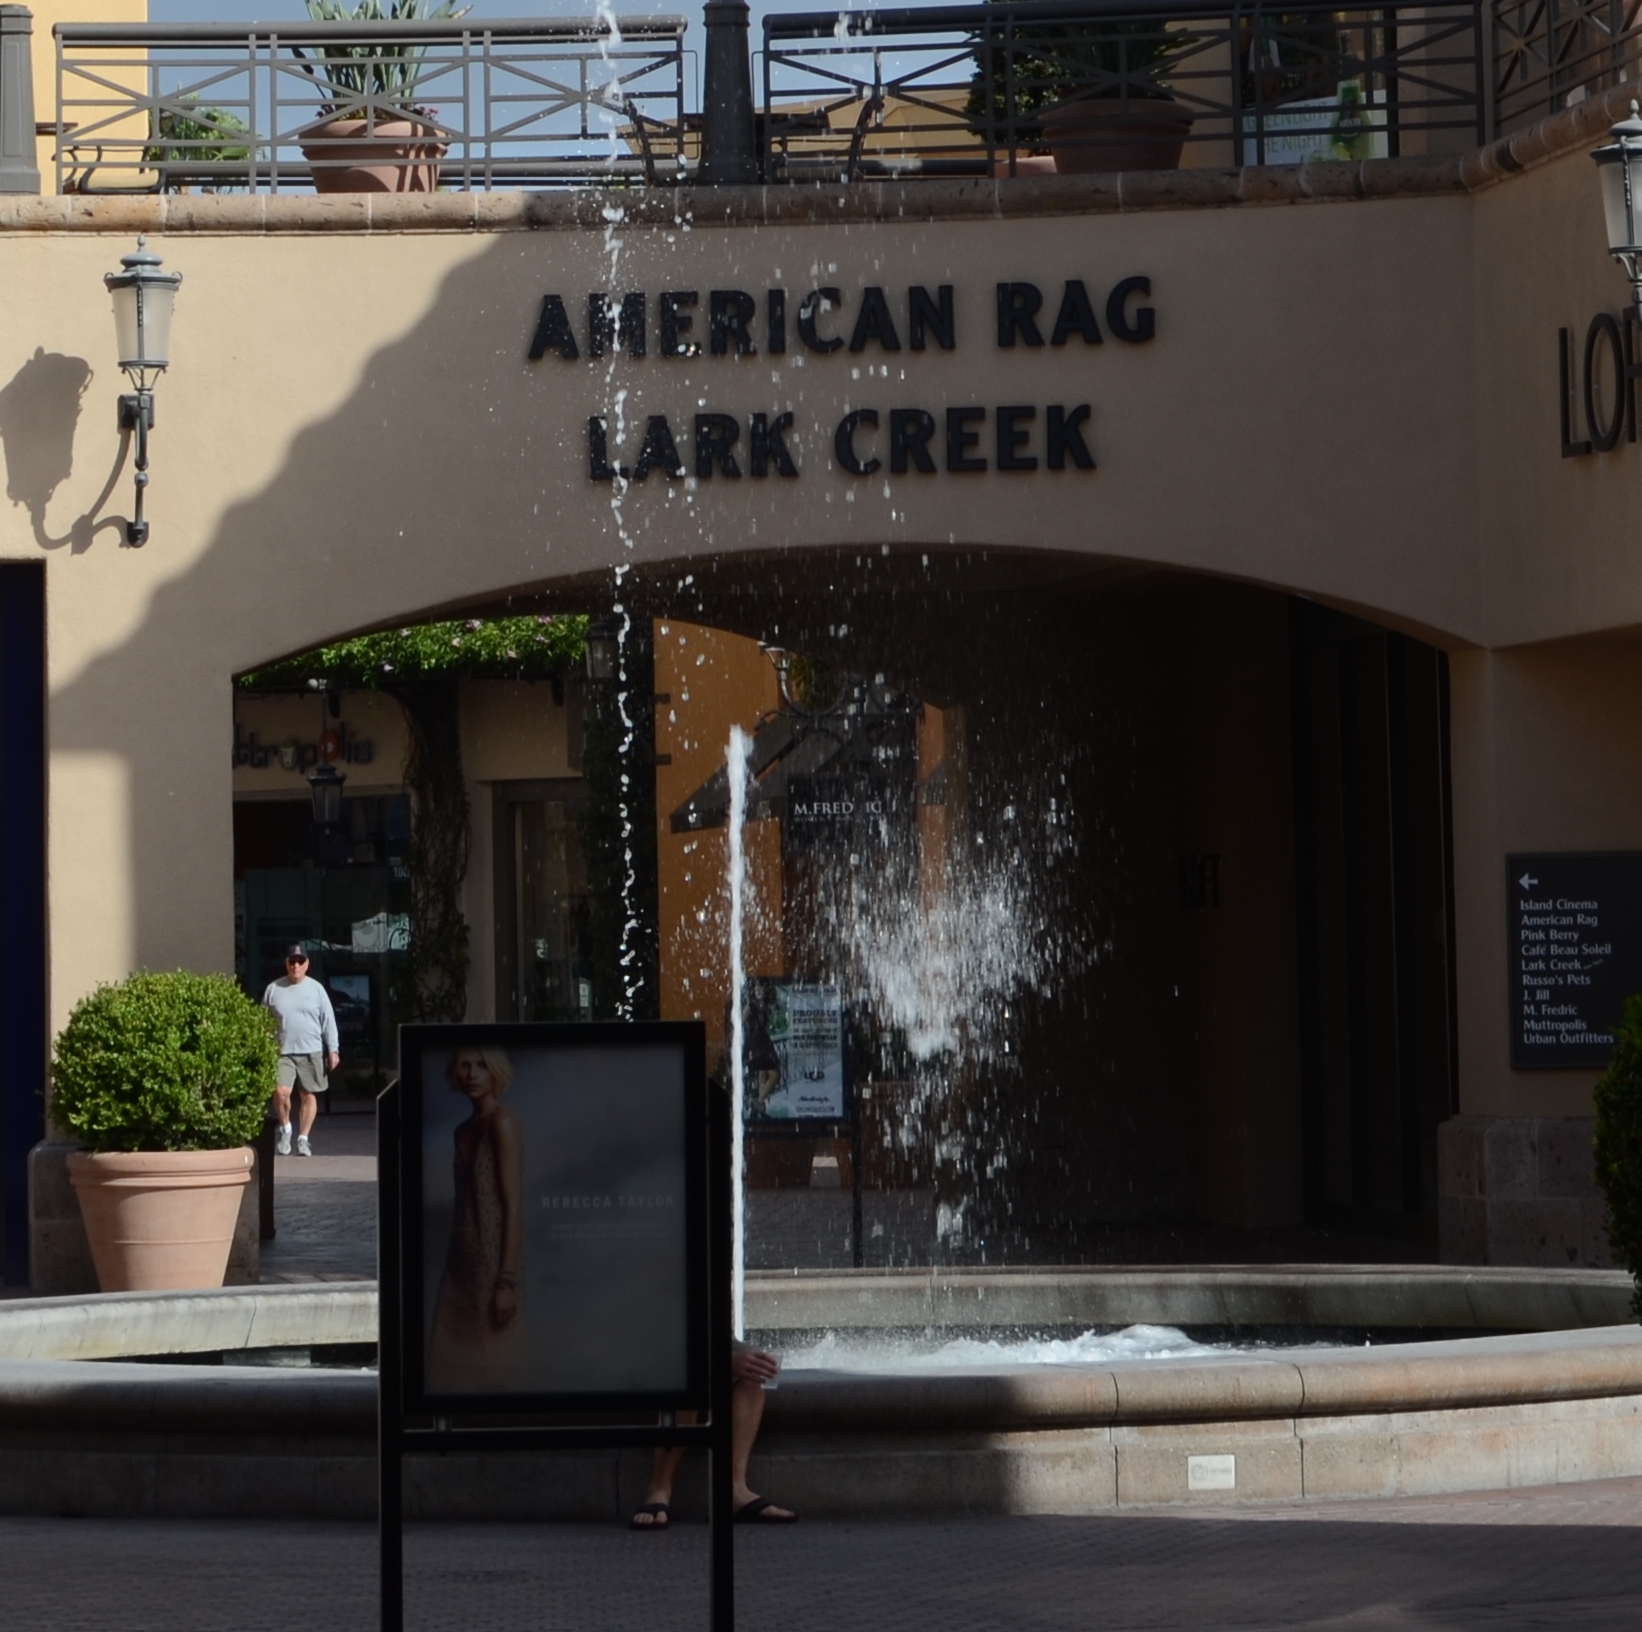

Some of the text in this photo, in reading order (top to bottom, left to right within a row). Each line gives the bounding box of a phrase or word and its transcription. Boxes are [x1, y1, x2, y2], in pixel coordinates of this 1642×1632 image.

[528, 276, 1156, 359] AMERICAN RAG
[588, 404, 1097, 482] LARK CREEK
[1520, 898, 1598, 910] Island Cinema
[1521, 913, 1598, 927] American Rag
[1521, 928, 1579, 942] Pink Berry
[1521, 942, 1611, 956] Café Beau Soleil
[1521, 959, 1546, 970] Lark
[1550, 958, 1581, 970] Creek
[1523, 974, 1591, 986] Russo's Pets
[1523, 990, 1550, 1000] J. Jill
[1523, 1004, 1578, 1016] M. Fredric
[1523, 1019, 1587, 1032] Muttropolis
[1524, 1032, 1614, 1044] Urban Outfitters
[541, 1194, 674, 1209] REBECCA TAYLOR
